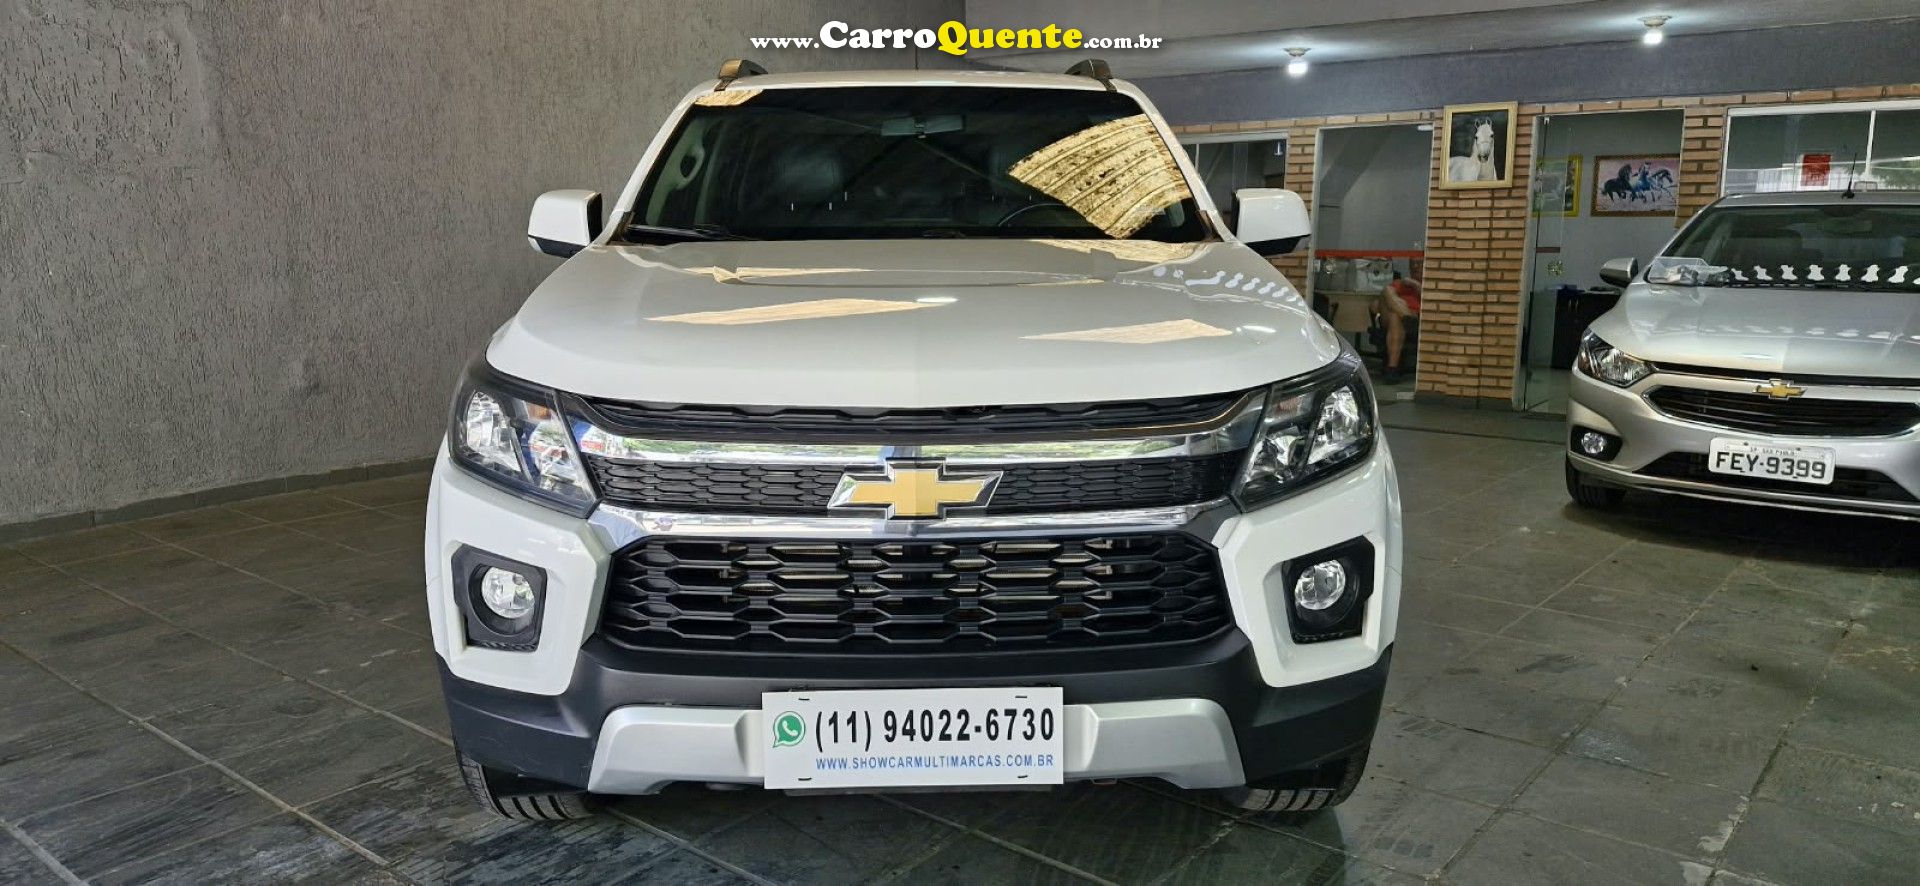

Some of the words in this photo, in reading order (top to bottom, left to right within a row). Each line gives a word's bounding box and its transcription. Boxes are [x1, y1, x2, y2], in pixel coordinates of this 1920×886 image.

[1716, 452, 1826, 479] FEY-9399
[815, 710, 871, 753] (11)
[883, 708, 1054, 742] 94022-6730
[816, 754, 1053, 770] WWW.SHOWCARMULTIMARCAS.COM.BR
